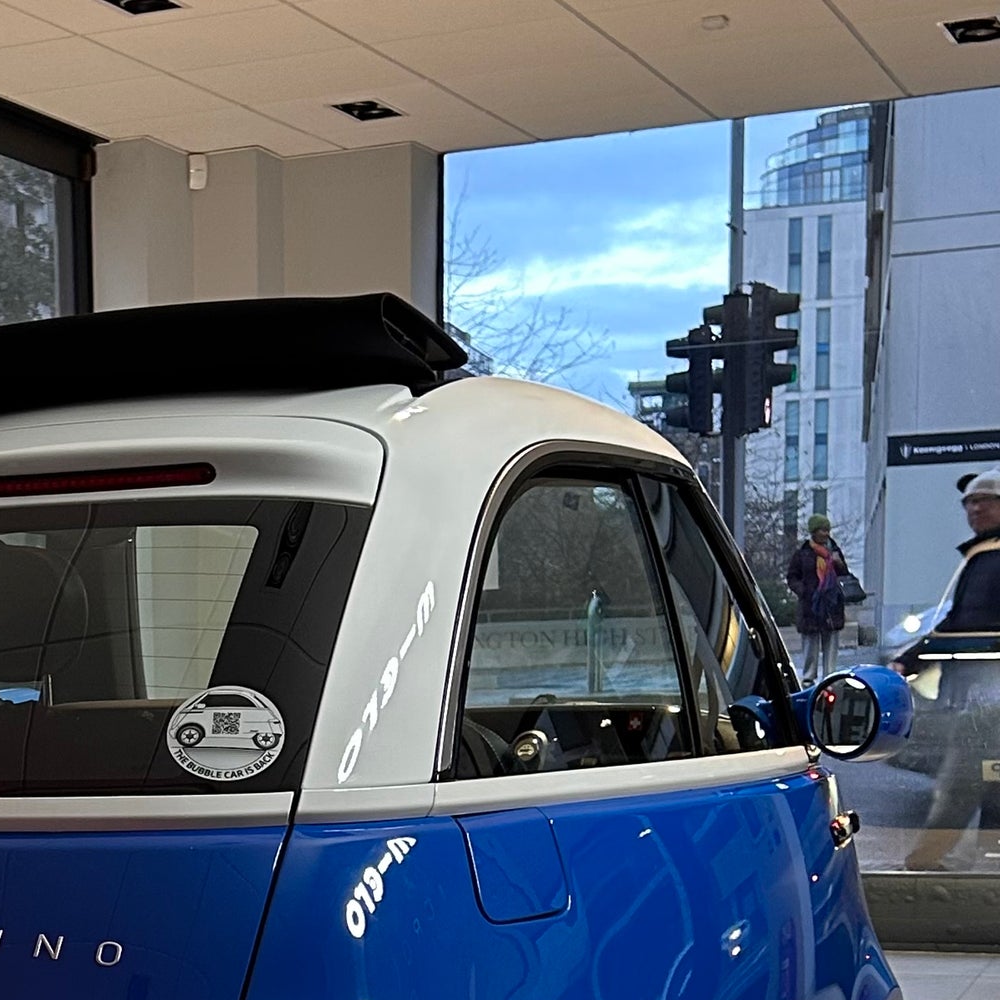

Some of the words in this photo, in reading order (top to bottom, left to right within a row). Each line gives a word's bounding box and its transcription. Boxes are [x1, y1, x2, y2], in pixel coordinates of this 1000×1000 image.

[174, 748, 188, 763] THE
[186, 759, 222, 778] BUBBLE
[224, 769, 243, 779] CAR
[245, 767, 254, 775] IS
[253, 751, 275, 770] BACK
